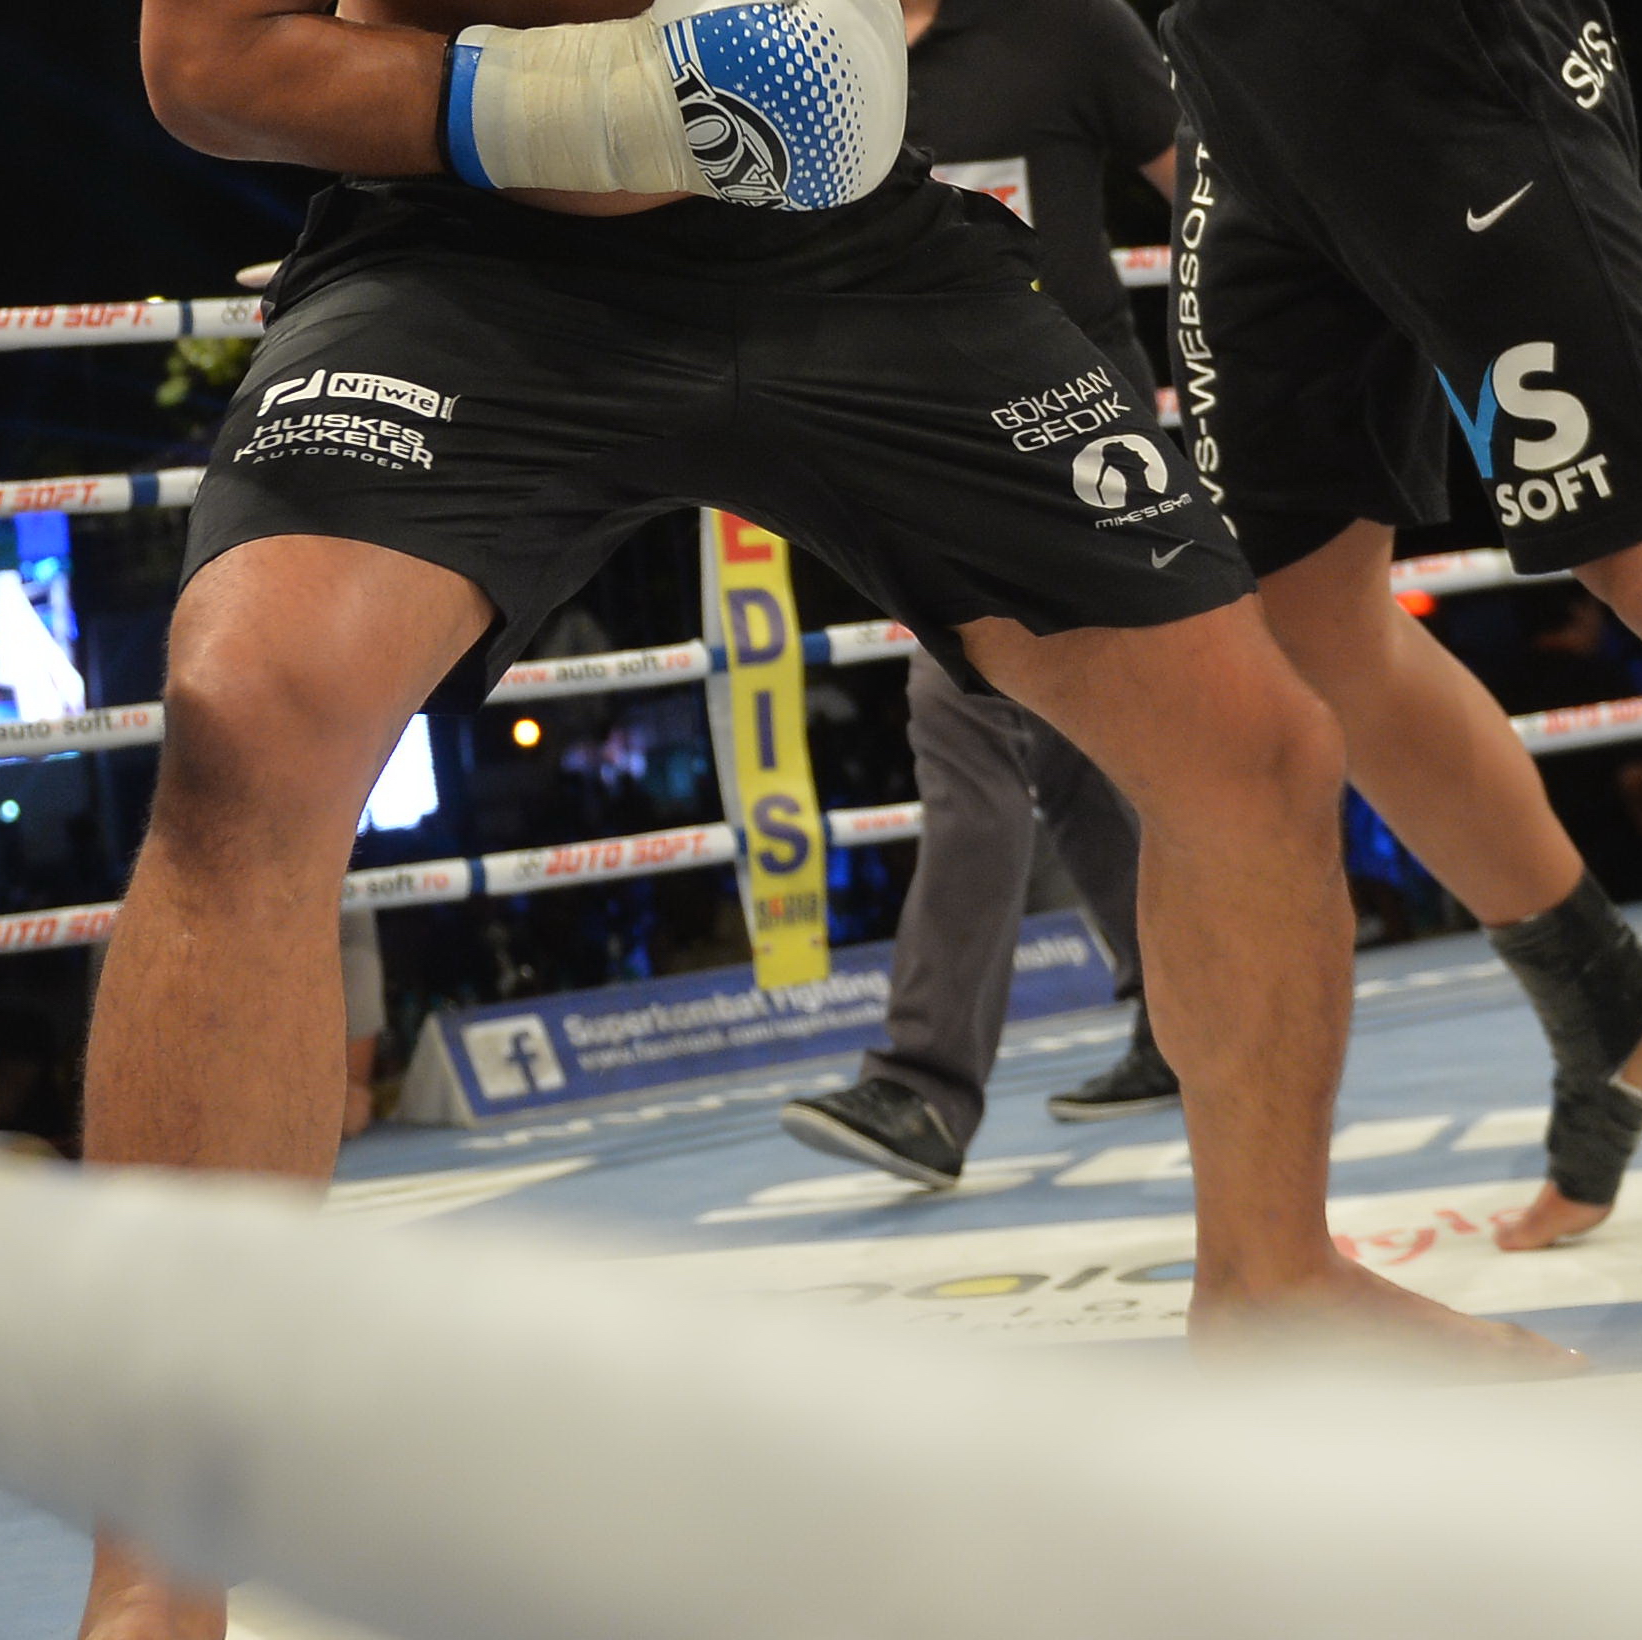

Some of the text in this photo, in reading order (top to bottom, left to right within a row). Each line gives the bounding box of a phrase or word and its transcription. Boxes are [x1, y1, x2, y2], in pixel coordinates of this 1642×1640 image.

[990, 366, 1113, 431] GÖKHAN
[1012, 392, 1131, 453] GEDIK
[232, 429, 434, 471] KOKKELER
[252, 413, 426, 448] HUISKES
[252, 446, 404, 471] AUTOGROEP
[1158, 492, 1194, 515] GYM
[1496, 453, 1612, 527] SOFT
[720, 510, 811, 877] EDIS
